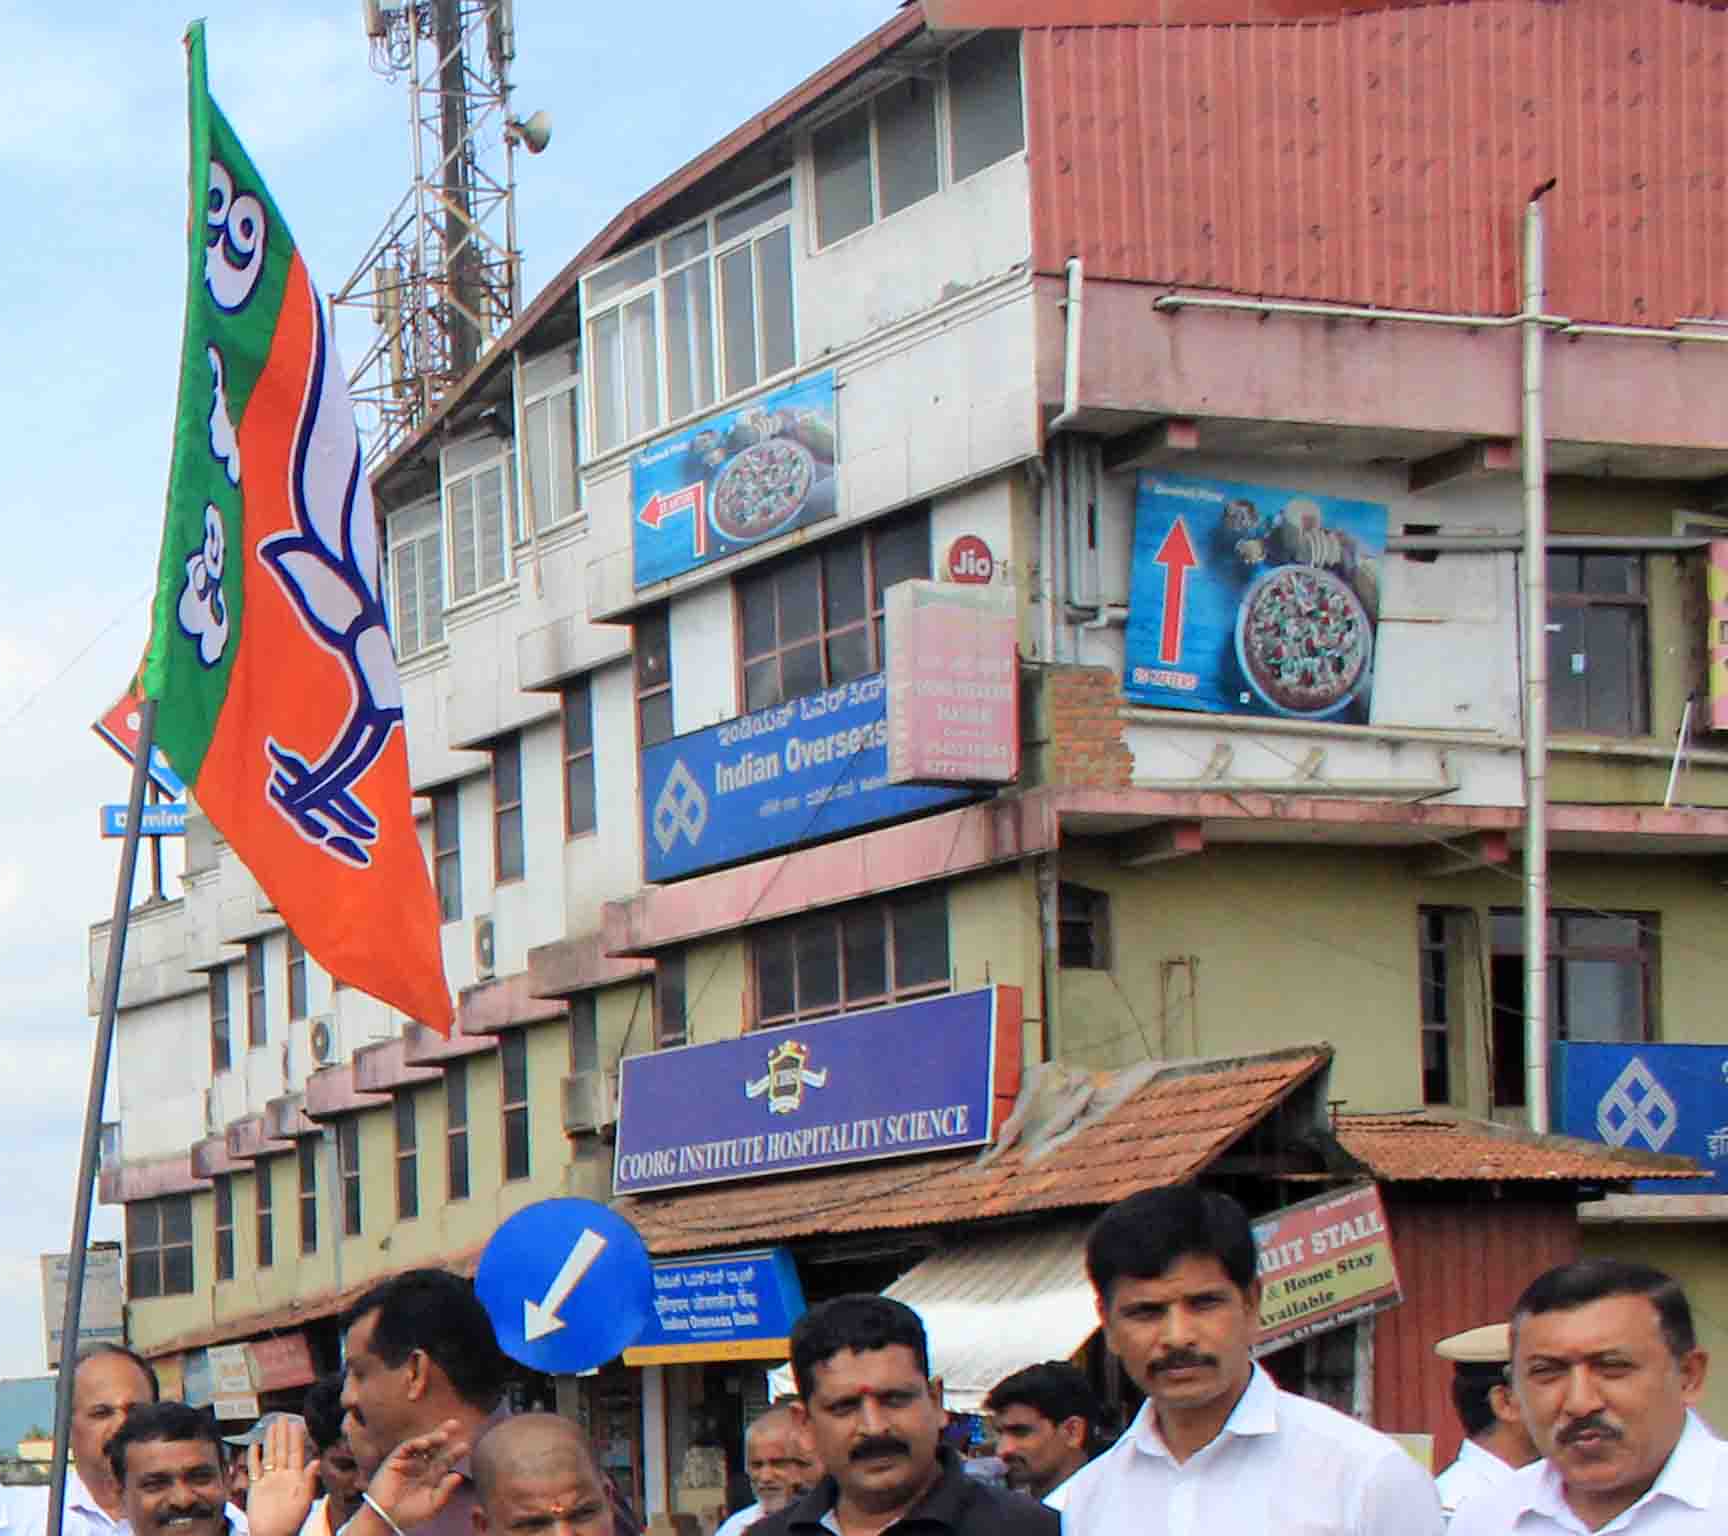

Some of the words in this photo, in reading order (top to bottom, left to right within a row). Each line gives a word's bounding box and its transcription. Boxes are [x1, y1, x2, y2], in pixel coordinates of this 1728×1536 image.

[954, 549, 992, 577] Jio
[715, 750, 783, 795] Indian
[785, 719, 887, 773] Overseas
[618, 1146, 677, 1183] COORG
[678, 1134, 766, 1175] INSTITUTE
[767, 1116, 885, 1162] HOSPITALITY
[886, 1104, 969, 1145] SCIENCE
[1311, 1210, 1384, 1255] STALL
[1284, 1268, 1335, 1295] Home
[1336, 1251, 1375, 1276] Stay
